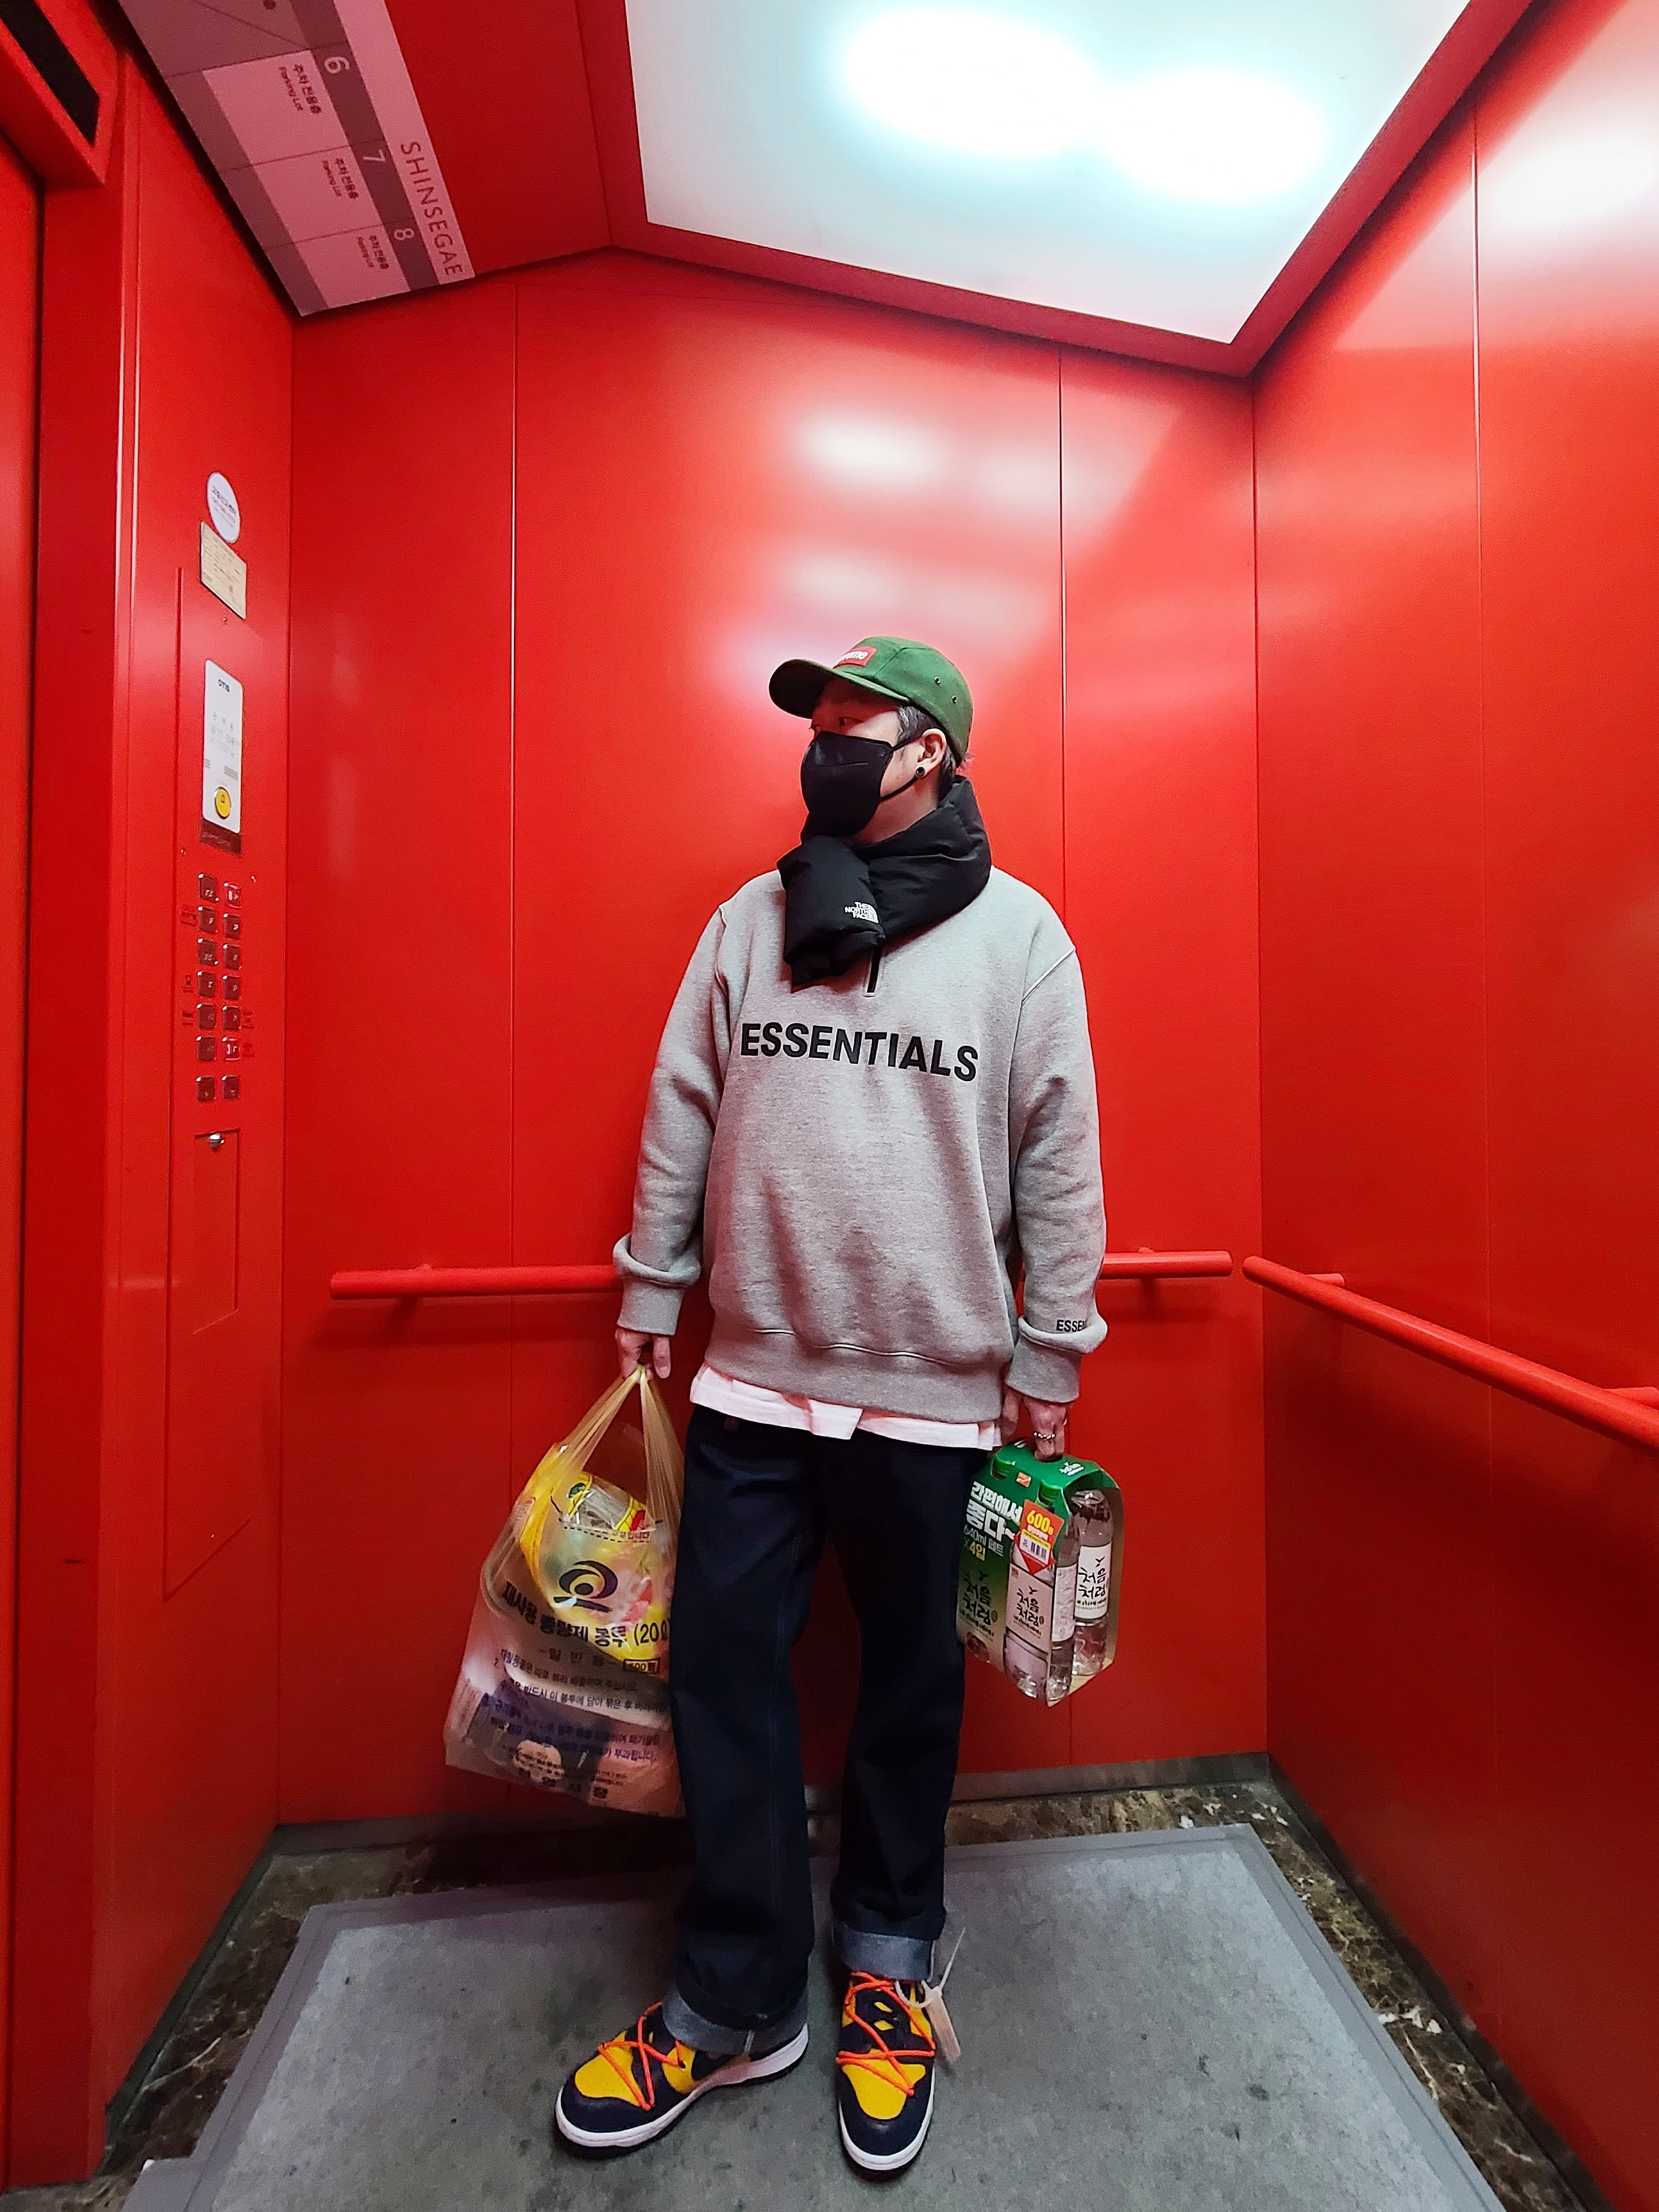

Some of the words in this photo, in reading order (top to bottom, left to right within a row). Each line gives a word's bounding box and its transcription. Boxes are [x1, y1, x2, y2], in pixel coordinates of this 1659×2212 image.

[324, 56, 350, 74] 6
[362, 150, 385, 163] 7
[401, 142, 463, 275] SHINSEGAE
[394, 228, 414, 241] 8
[218, 679, 230, 692] OTIS
[844, 906, 869, 914] NORTH
[741, 1022, 978, 1081] ESSENTIALS
[963, 1524, 986, 1546] 640ml
[988, 1538, 1003, 1557] 페트
[1078, 1567, 1106, 1584] 처음
[595, 1626, 627, 1647] 봉투
[524, 1683, 547, 1699] 반드시
[550, 1691, 558, 1702] 이
[561, 1692, 584, 1706] 봉투에
[588, 1696, 603, 1708] 담아
